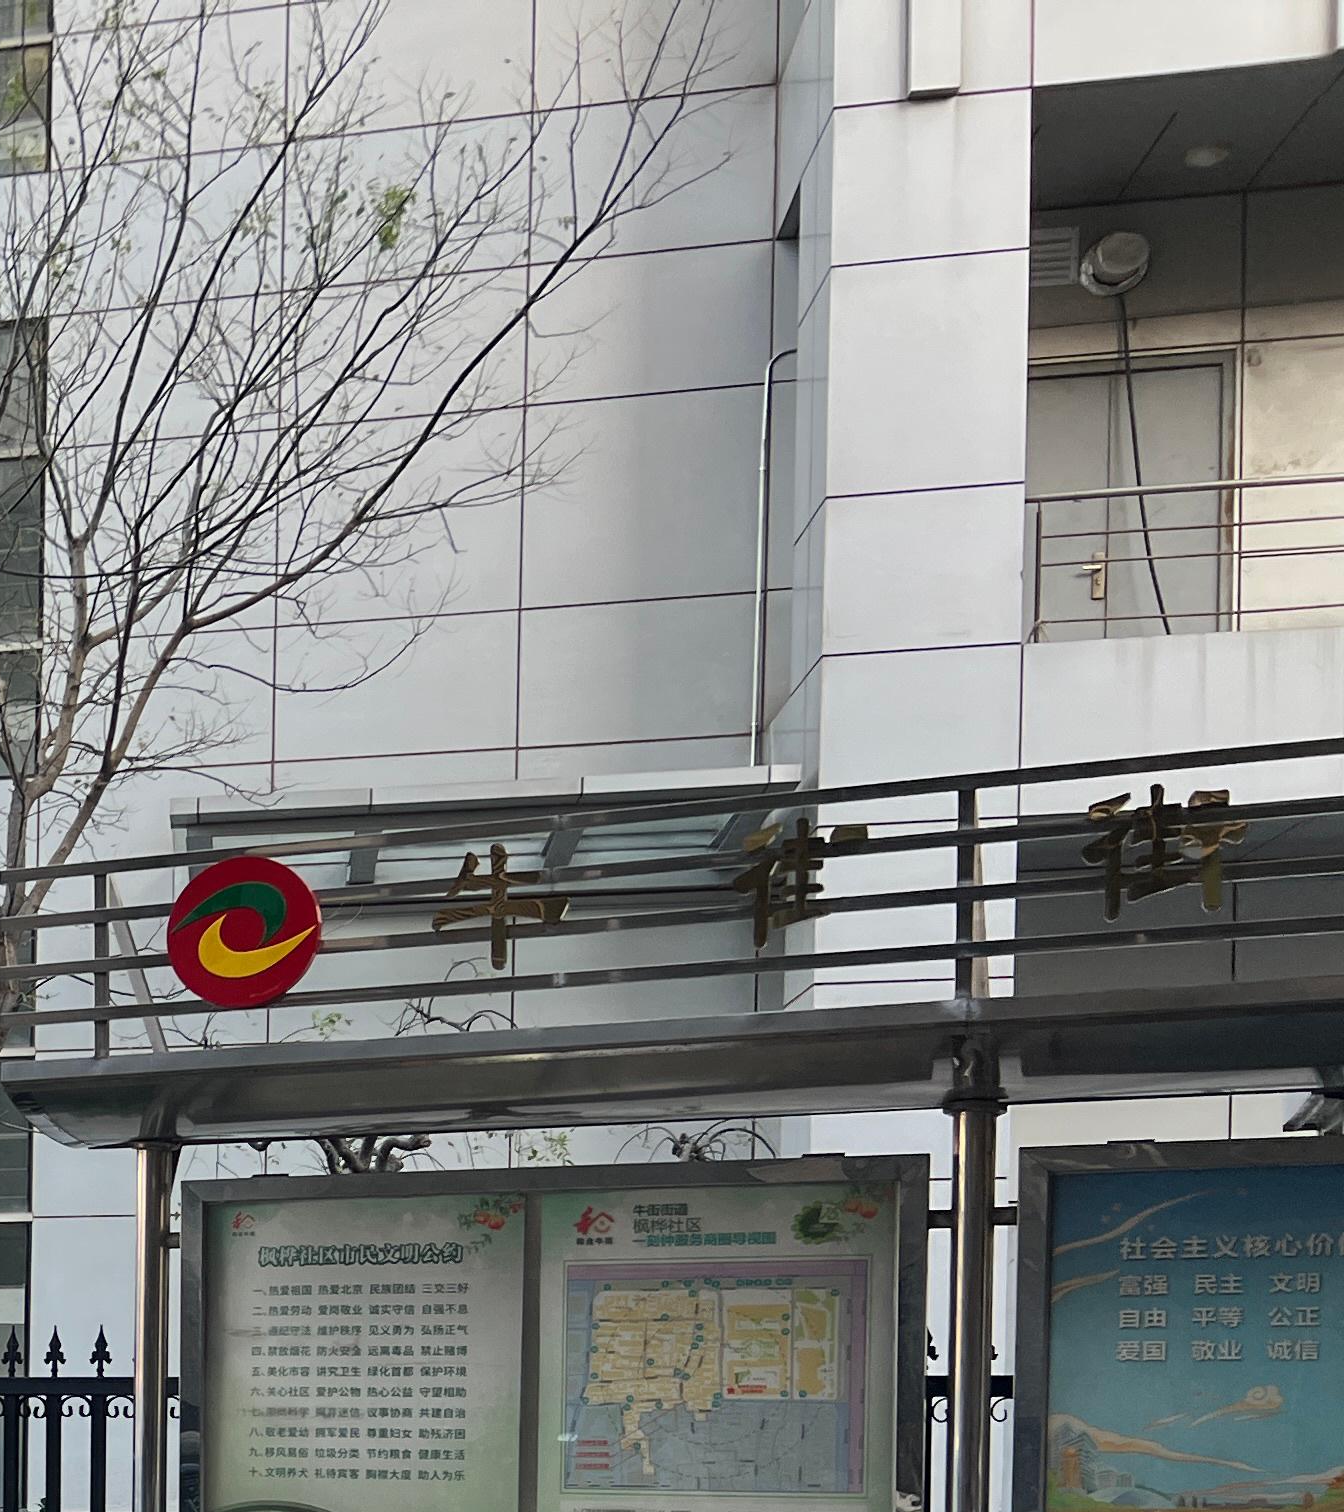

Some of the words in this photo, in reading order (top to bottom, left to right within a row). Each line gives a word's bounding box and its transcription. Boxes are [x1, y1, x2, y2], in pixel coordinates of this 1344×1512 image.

[633, 1217, 702, 1233] 枫桦社区
[1120, 1232, 1344, 1261] 社会主义核心价
[258, 1242, 464, 1267] 枫桦社区市民文明公约
[318, 1284, 363, 1295] 热爱北京
[369, 1283, 415, 1294] 民族团结
[1118, 1274, 1169, 1296] 富强
[1194, 1273, 1245, 1295] 民主
[1269, 1272, 1321, 1293] 文明
[318, 1305, 362, 1315] 爱岗敬业
[369, 1304, 415, 1315] 诚实守信
[421, 1304, 468, 1315] 自强不息
[1119, 1307, 1167, 1329] 自由
[1192, 1306, 1244, 1328] 平等
[1268, 1306, 1321, 1327] 公正
[317, 1325, 362, 1336] 维护秩序
[368, 1325, 414, 1336] 见义勇为
[421, 1324, 468, 1336] 弘扬正气
[316, 1345, 361, 1357] 防火安全
[367, 1345, 414, 1357] 远离毒品
[420, 1345, 467, 1357] 禁止赌博
[1116, 1340, 1167, 1361] 爱国
[1191, 1340, 1243, 1361] 敬业
[1267, 1339, 1320, 1360] 诚信
[316, 1366, 361, 1377] 讲究卫生
[367, 1366, 413, 1377] 绿化首都
[420, 1366, 467, 1377] 保护环境
[316, 1387, 361, 1398] 爱护公物
[367, 1387, 413, 1398] 热心公益
[419, 1386, 466, 1398] 守望相助
[366, 1407, 412, 1418] 议事协商
[419, 1407, 466, 1418] 共建自治
[315, 1427, 360, 1438] 拥军爱民
[366, 1427, 412, 1439] 尊重妇女
[418, 1427, 466, 1439] 助残济困
[315, 1448, 360, 1459] 垃圾分类
[366, 1448, 412, 1459] 节约粮食
[418, 1449, 465, 1460] 健康生活
[315, 1468, 360, 1479] 礼待宾客
[365, 1469, 412, 1480] 胸襟大度
[418, 1470, 465, 1481] 助人为乐
